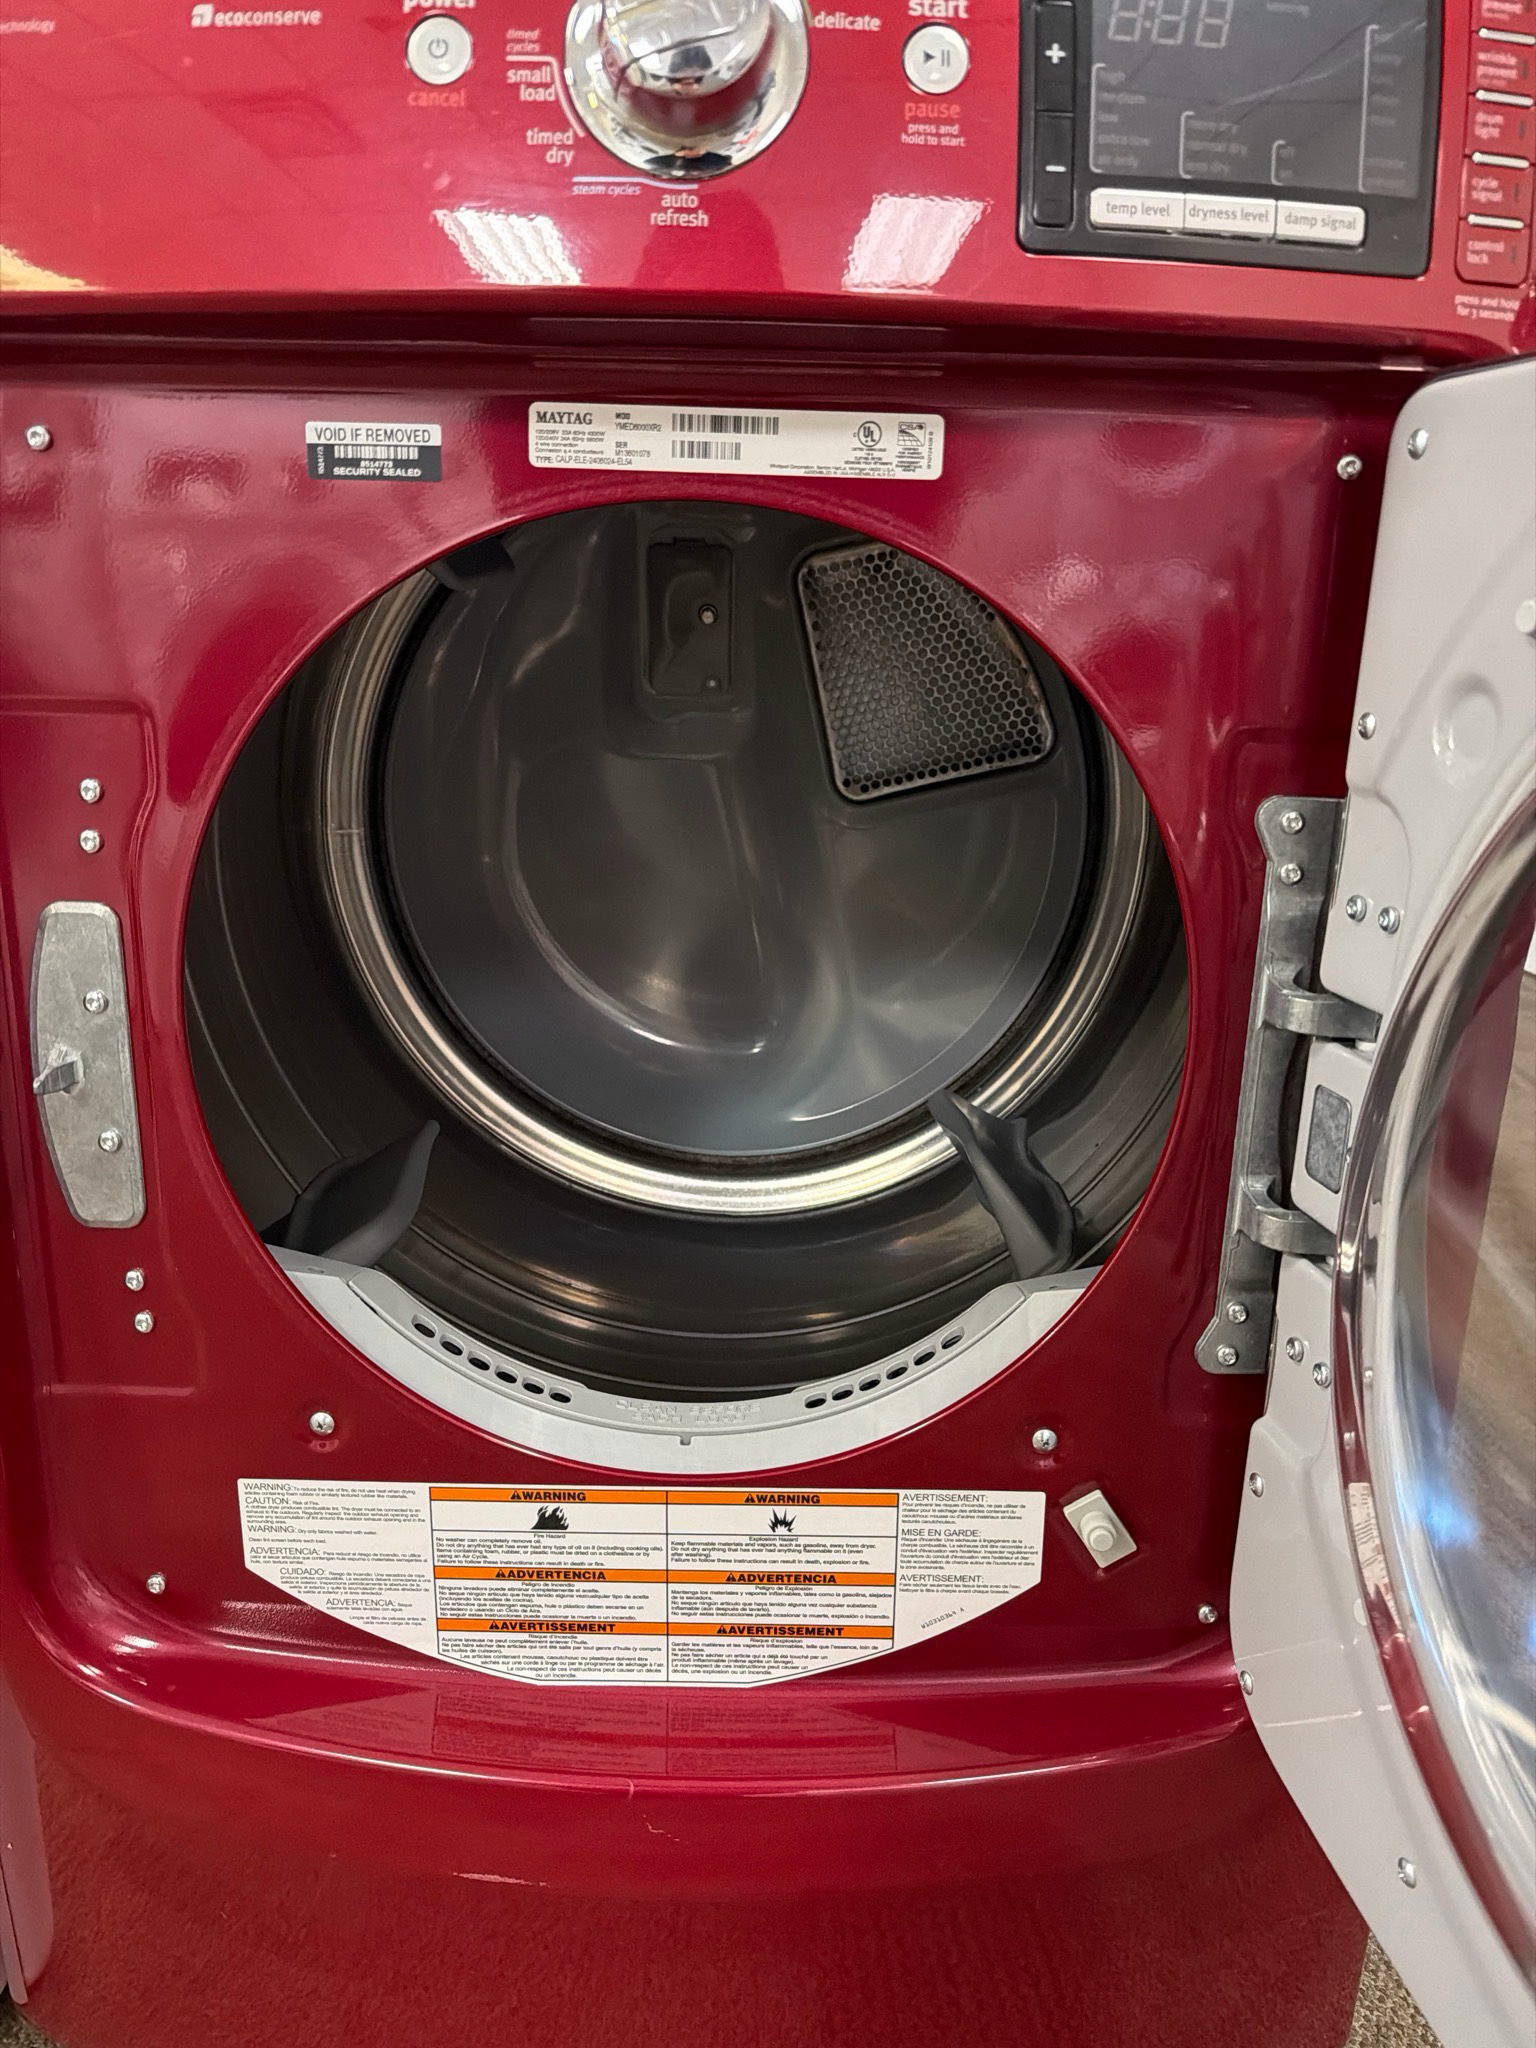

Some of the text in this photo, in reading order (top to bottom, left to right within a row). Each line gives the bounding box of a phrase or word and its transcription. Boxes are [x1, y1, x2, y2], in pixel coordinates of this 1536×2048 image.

[908, 0, 969, 18] start
[214, 9, 322, 26] ecoconserve
[814, 11, 881, 31] delicate
[506, 28, 540, 40] timed
[506, 41, 540, 53] cycles
[506, 66, 551, 82] small
[408, 90, 464, 107] cancel
[520, 84, 555, 102] load
[904, 102, 960, 120] pause
[908, 124, 958, 135] press and
[526, 128, 574, 144] timed
[902, 134, 965, 146] hold to start
[546, 147, 574, 166] dry
[572, 184, 640, 197] steam cycles
[661, 194, 698, 208] auto
[1106, 201, 1170, 217] temp level
[1188, 206, 1269, 223] dryness level
[650, 209, 708, 227] refresh
[1284, 212, 1357, 231] damp signal
[1471, 308, 1477, 318] 3
[536, 411, 593, 425] MAYTAG
[314, 427, 431, 443] VOID IF REMOVED
[333, 467, 422, 477] SECURITY SEALED
[243, 1482, 293, 1491] WARNING:
[245, 1496, 291, 1505] CAUTION:
[522, 1491, 586, 1501] WARNING
[756, 1495, 820, 1504] WARNING
[902, 1493, 988, 1502] AVERTISSEMENT:
[247, 1525, 297, 1534] WARNING:
[944, 1529, 981, 1537] GARDE:
[250, 1546, 320, 1555] ADVERTENCIA:
[507, 1570, 606, 1580] ADVERTENCIA
[738, 1574, 836, 1583] ADVERTENCIA
[899, 1574, 984, 1582] AVERTISSEMENT:
[326, 1598, 396, 1606] ADVERTENCIA:
[501, 1622, 616, 1632] AVERTISSEMENT
[729, 1626, 844, 1636] AVERTISSEMENT
